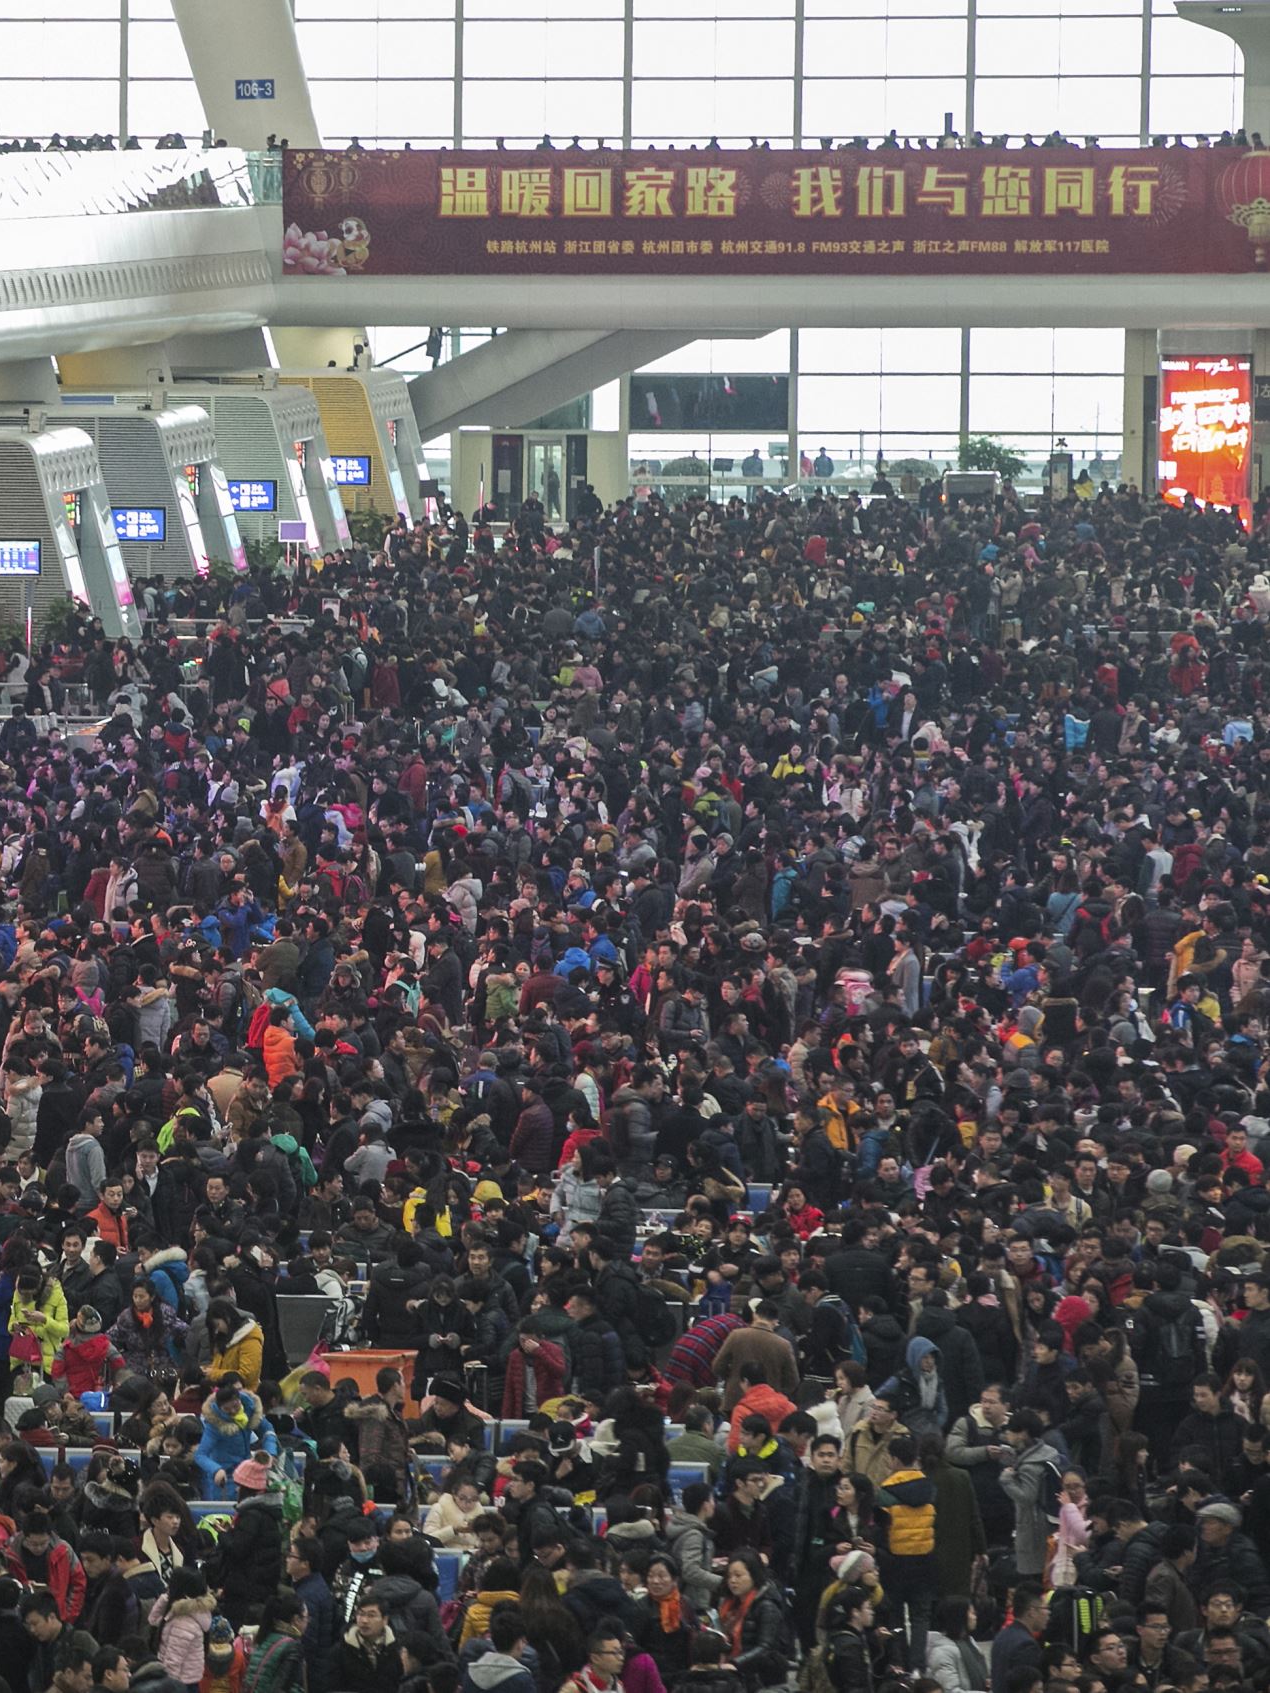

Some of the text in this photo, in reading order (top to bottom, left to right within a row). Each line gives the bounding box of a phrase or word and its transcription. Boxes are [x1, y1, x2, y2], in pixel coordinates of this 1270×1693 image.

[237, 82, 273, 97] 106-3
[440, 165, 1160, 217] 温暖回家路 我们与您同行
[486, 240, 1110, 255] 铁路杭州站 浙江团省委 杭州团市委 杭州交通91.8 FM93交通之声 浙江之声FM88 解放军117医院
